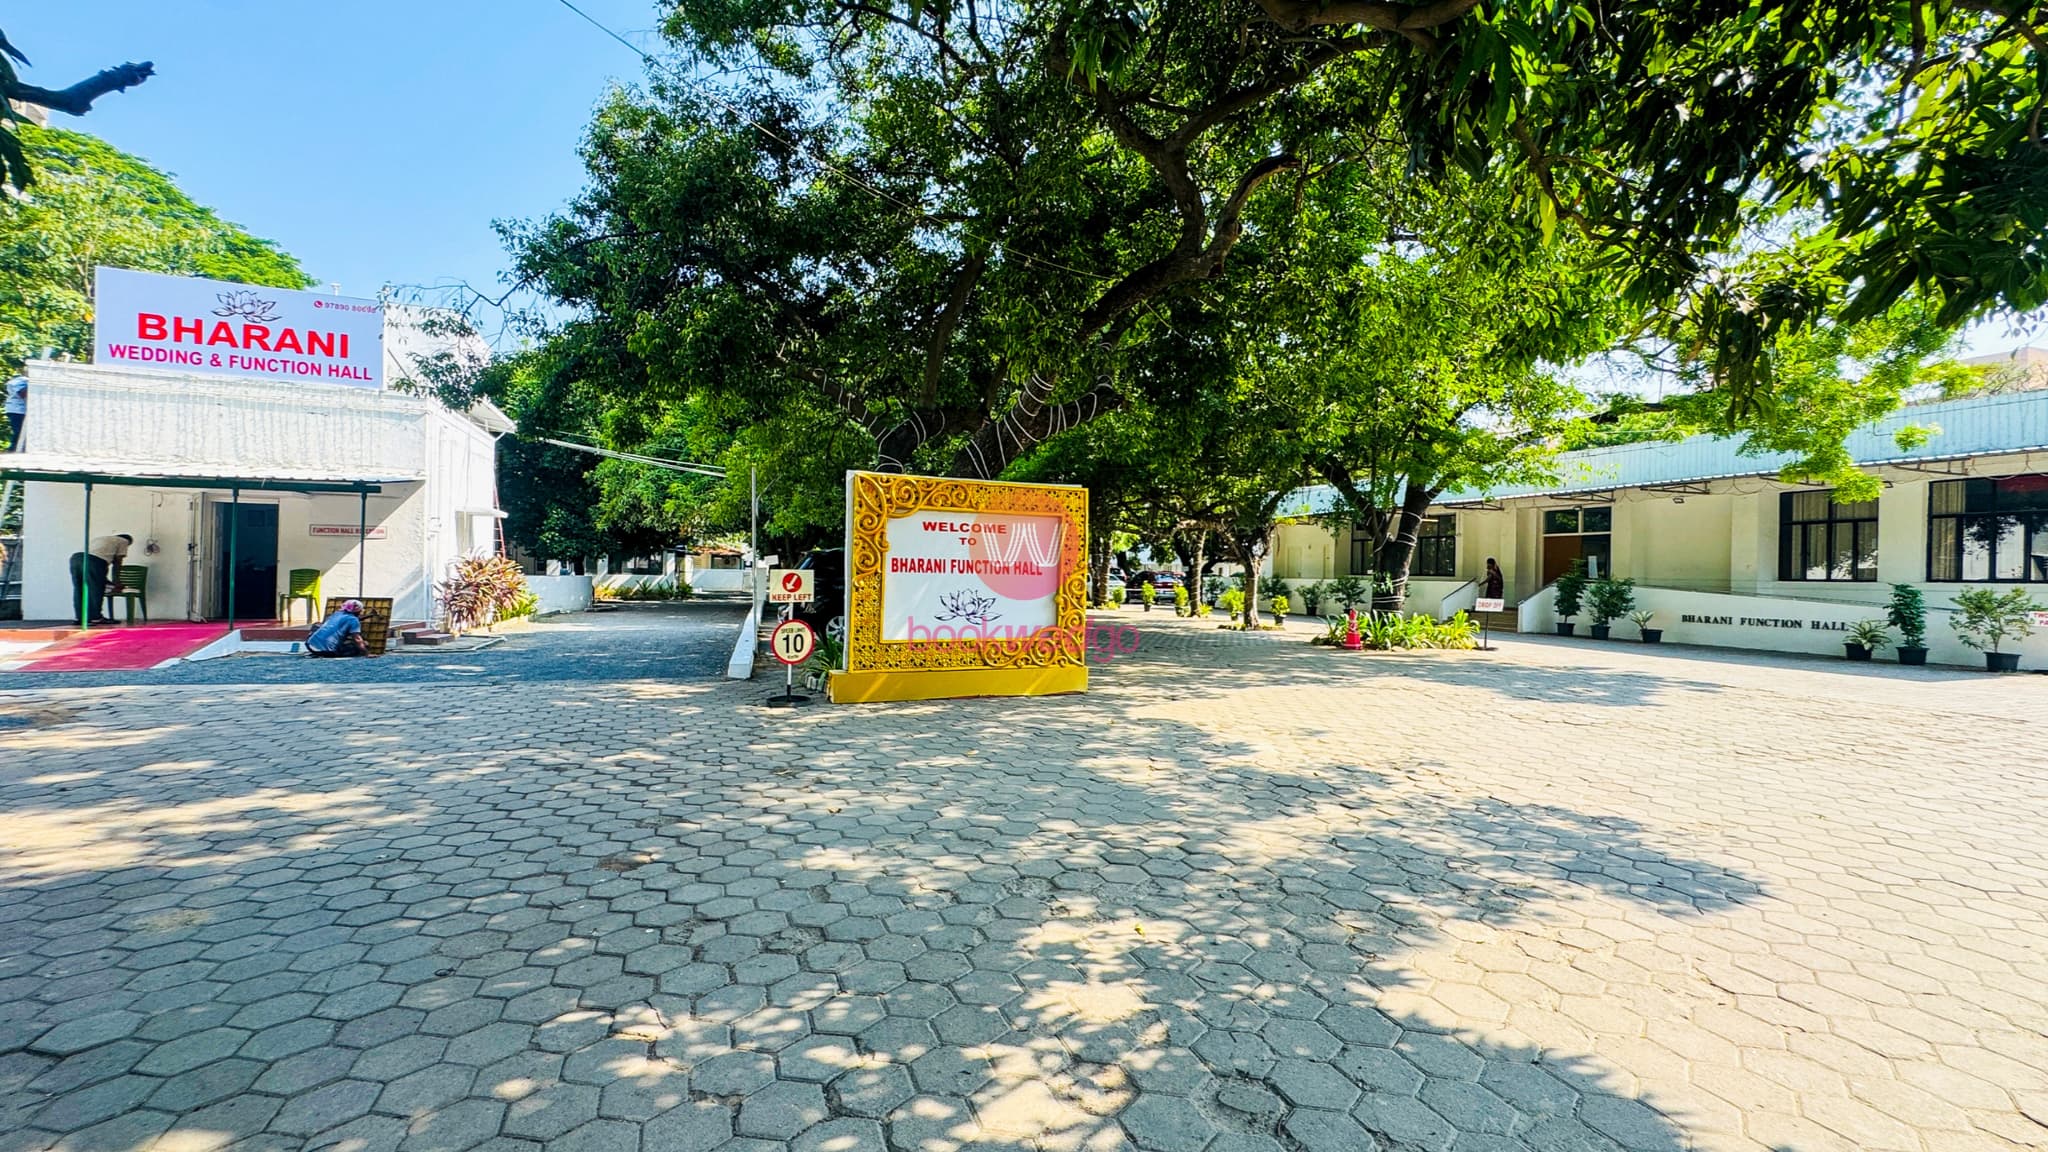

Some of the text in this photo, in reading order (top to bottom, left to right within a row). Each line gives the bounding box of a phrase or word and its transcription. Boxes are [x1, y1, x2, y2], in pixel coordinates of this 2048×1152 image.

[137, 312, 349, 359] BHARANI
[108, 343, 373, 381] WEDDING & FUNCTION HALL
[922, 521, 1008, 535] WELCOME
[959, 537, 977, 545] TO
[891, 557, 1042, 576] BHARANI FUNCTION HALL
[1681, 615, 1849, 631] BHARANI FUNCTION HALL
[782, 634, 804, 653] 10
